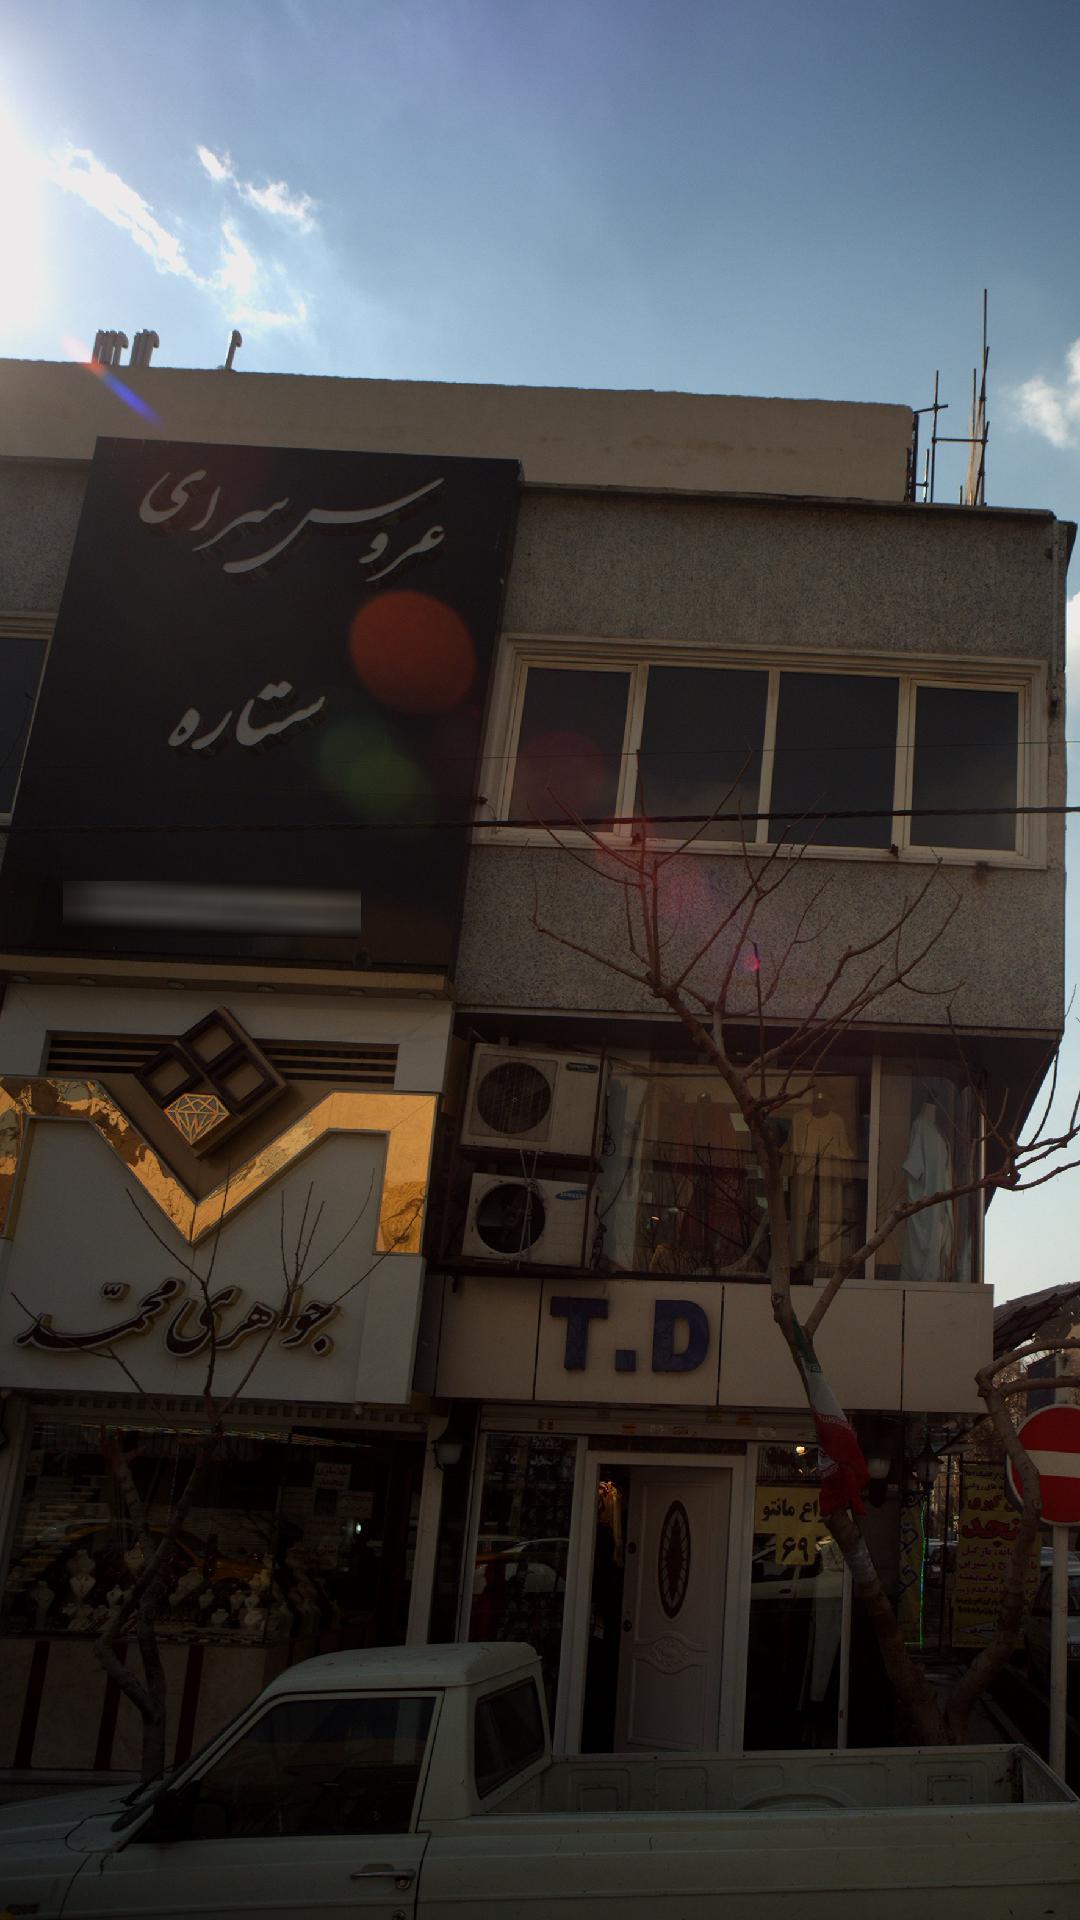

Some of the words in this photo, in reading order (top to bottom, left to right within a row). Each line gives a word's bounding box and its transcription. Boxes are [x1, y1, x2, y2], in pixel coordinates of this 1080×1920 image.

[168, 680, 326, 750] ستاره
[550, 1296, 710, 1372] T.D
[761, 1498, 795, 1521] مانتو
